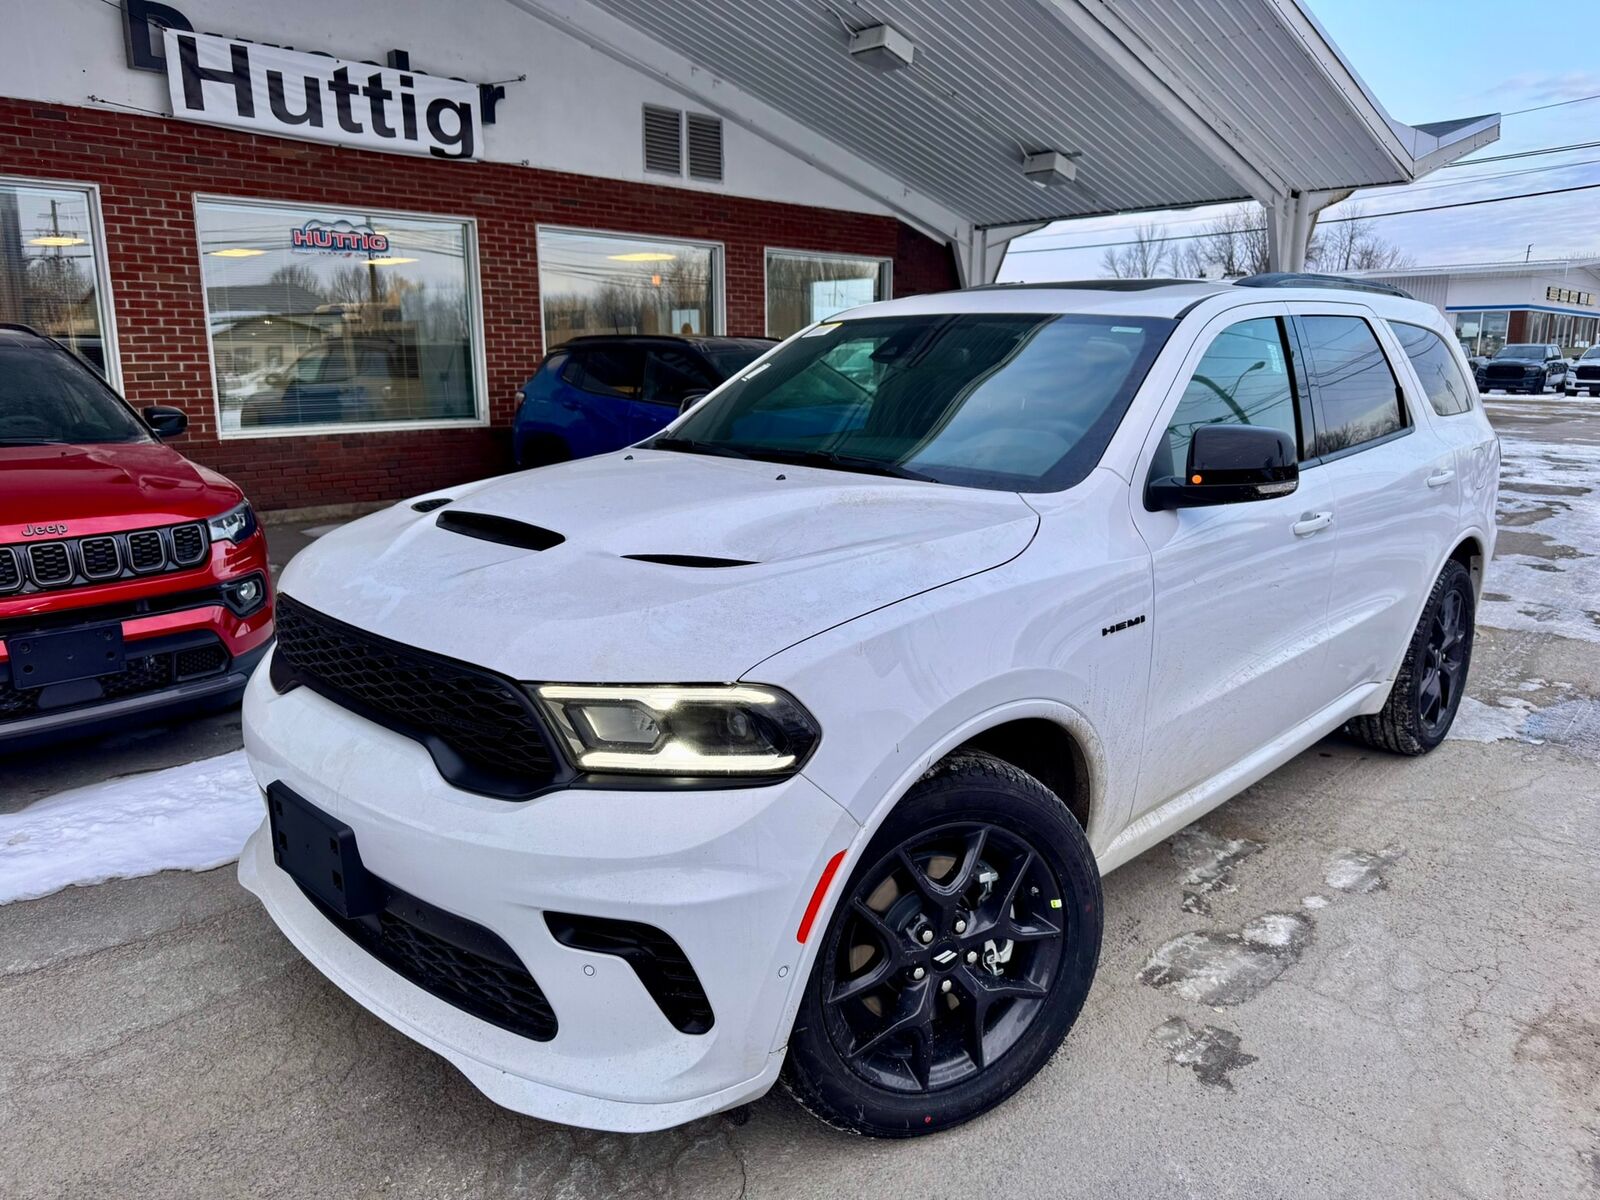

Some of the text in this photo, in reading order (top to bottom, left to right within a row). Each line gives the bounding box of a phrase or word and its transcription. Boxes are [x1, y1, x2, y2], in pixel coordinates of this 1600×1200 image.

[177, 34, 474, 160] Huttig
[292, 228, 389, 252] HUTTIG
[22, 522, 69, 537] Jeep
[1102, 615, 1146, 637] HEMI
